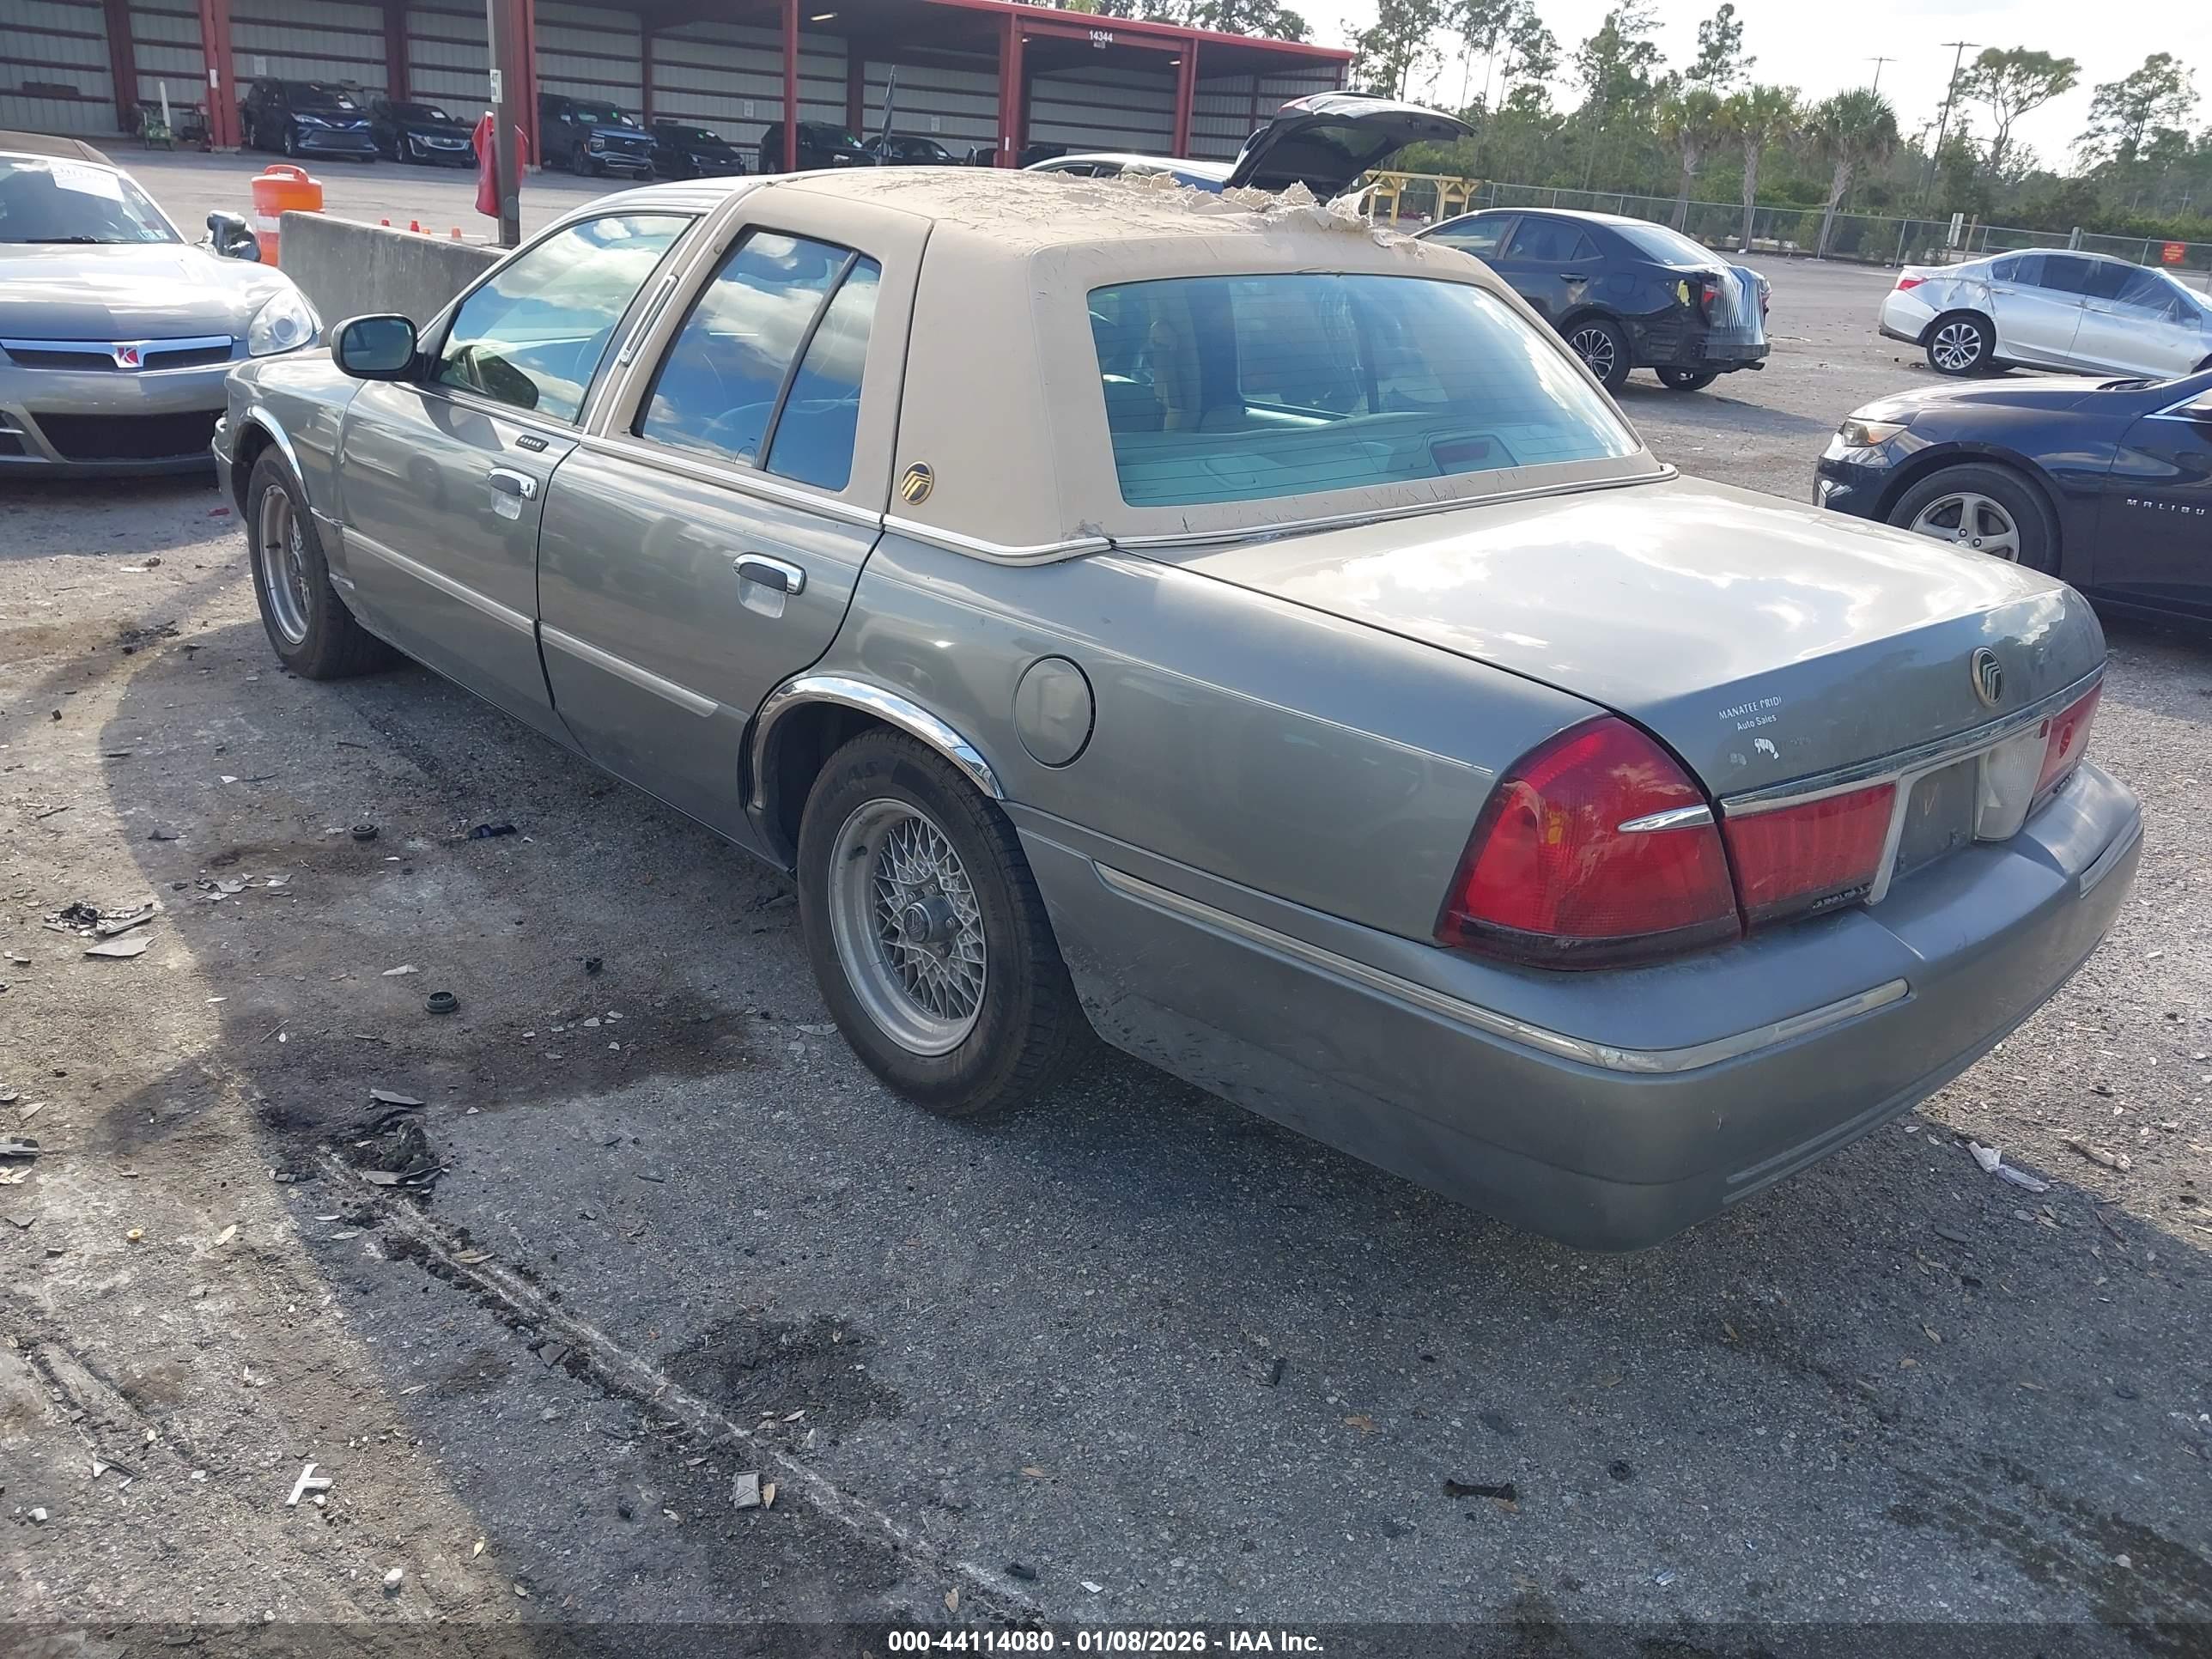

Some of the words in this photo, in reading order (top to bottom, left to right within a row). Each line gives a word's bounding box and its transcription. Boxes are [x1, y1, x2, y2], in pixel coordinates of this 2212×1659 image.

[1089, 29, 1113, 42] 14344
[2127, 499, 2205, 515] MALIBU
[1718, 702, 1759, 720] MANATEE
[1737, 721, 1754, 732] Auto
[1756, 714, 1778, 726] Sales
